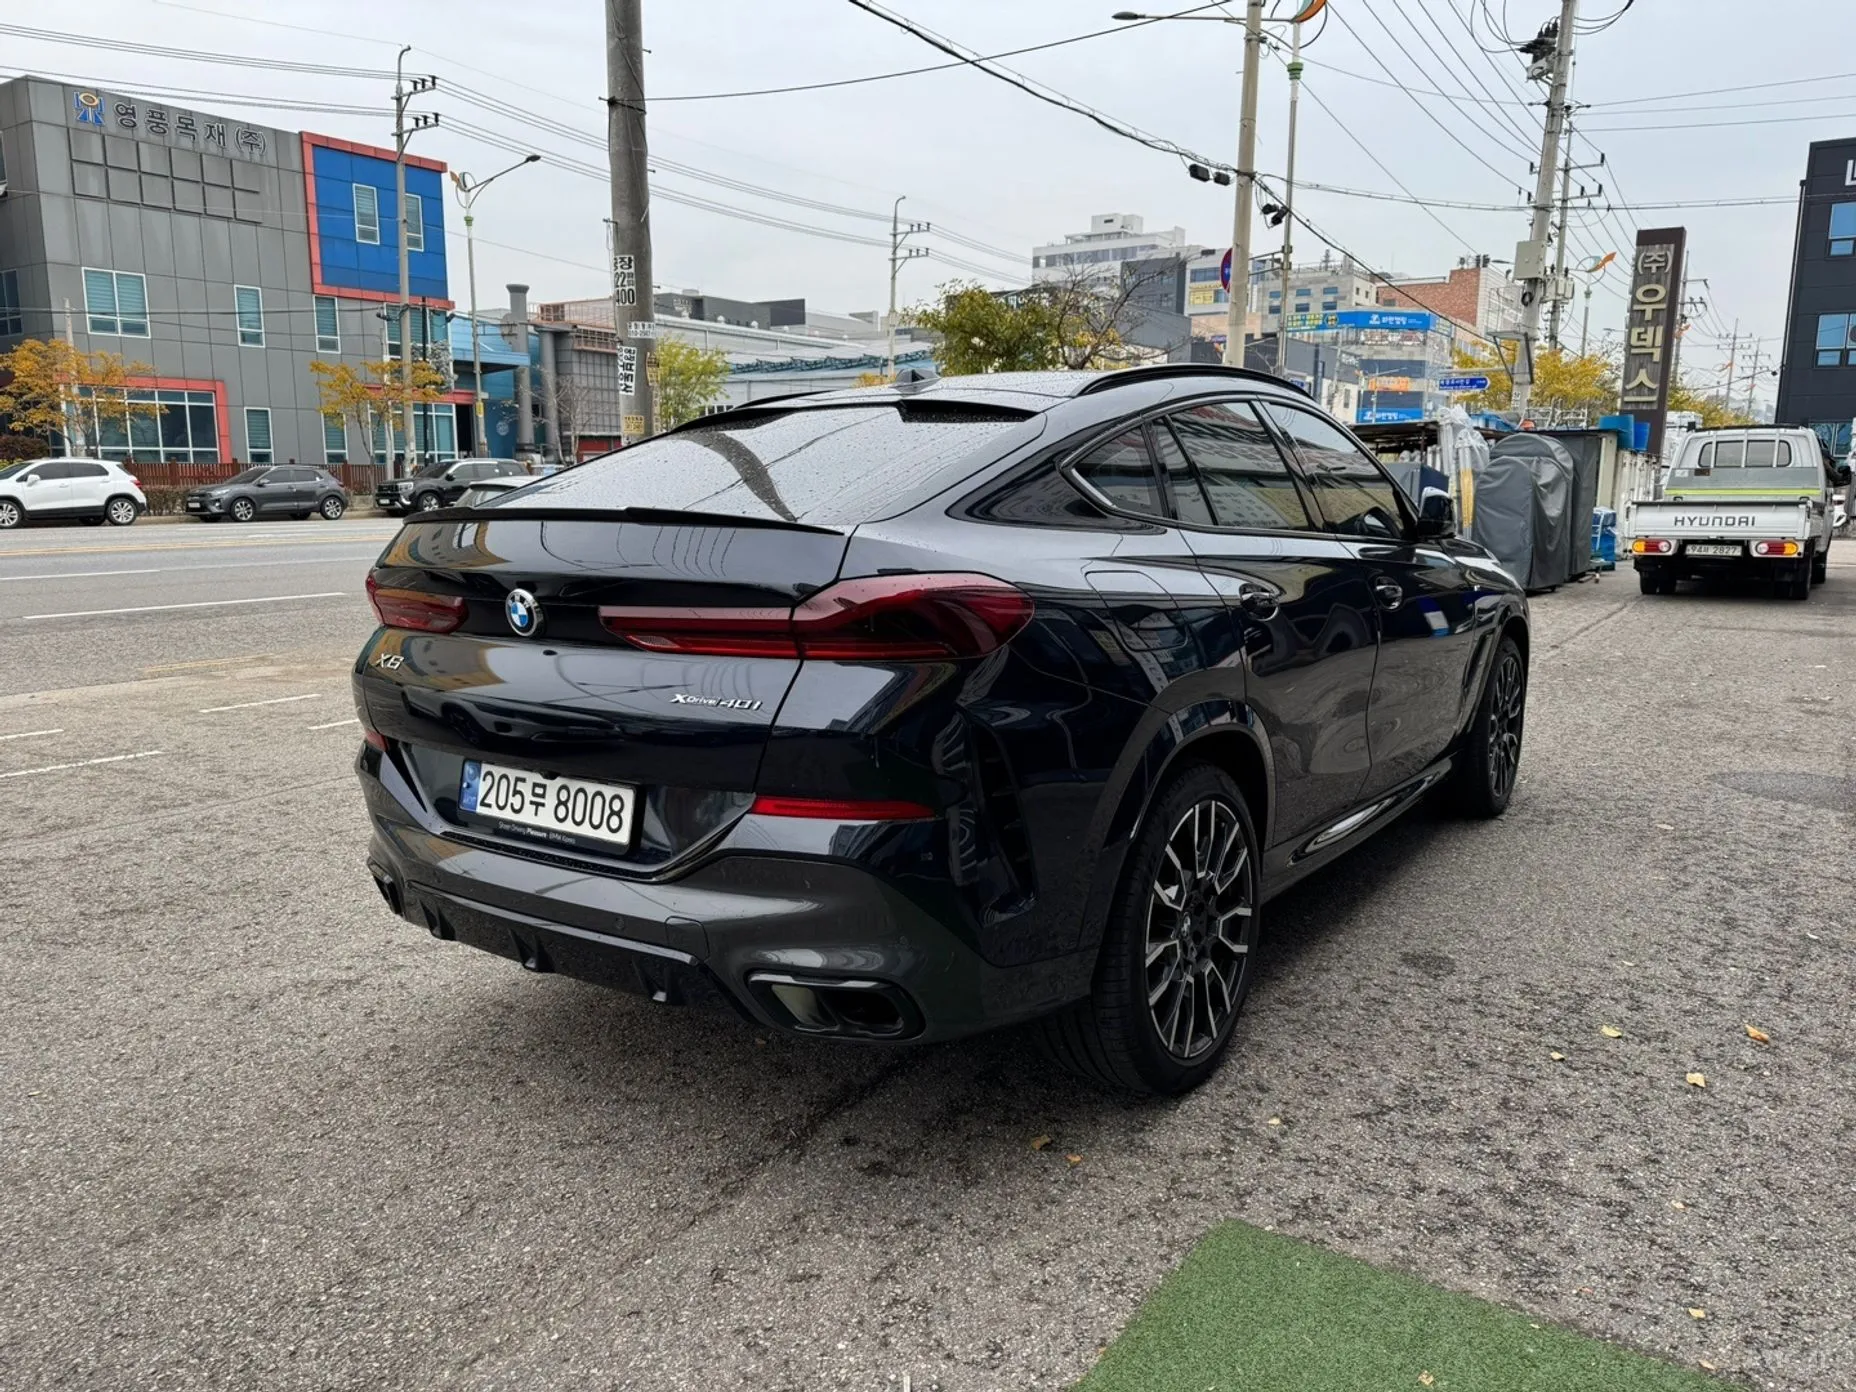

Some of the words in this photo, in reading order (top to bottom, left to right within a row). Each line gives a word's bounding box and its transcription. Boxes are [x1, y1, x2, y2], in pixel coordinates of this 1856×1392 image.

[1674, 515, 1756, 527] HYUNDAI
[376, 653, 405, 670] X6
[479, 770, 548, 817] 205무
[554, 784, 625, 833] 8008
